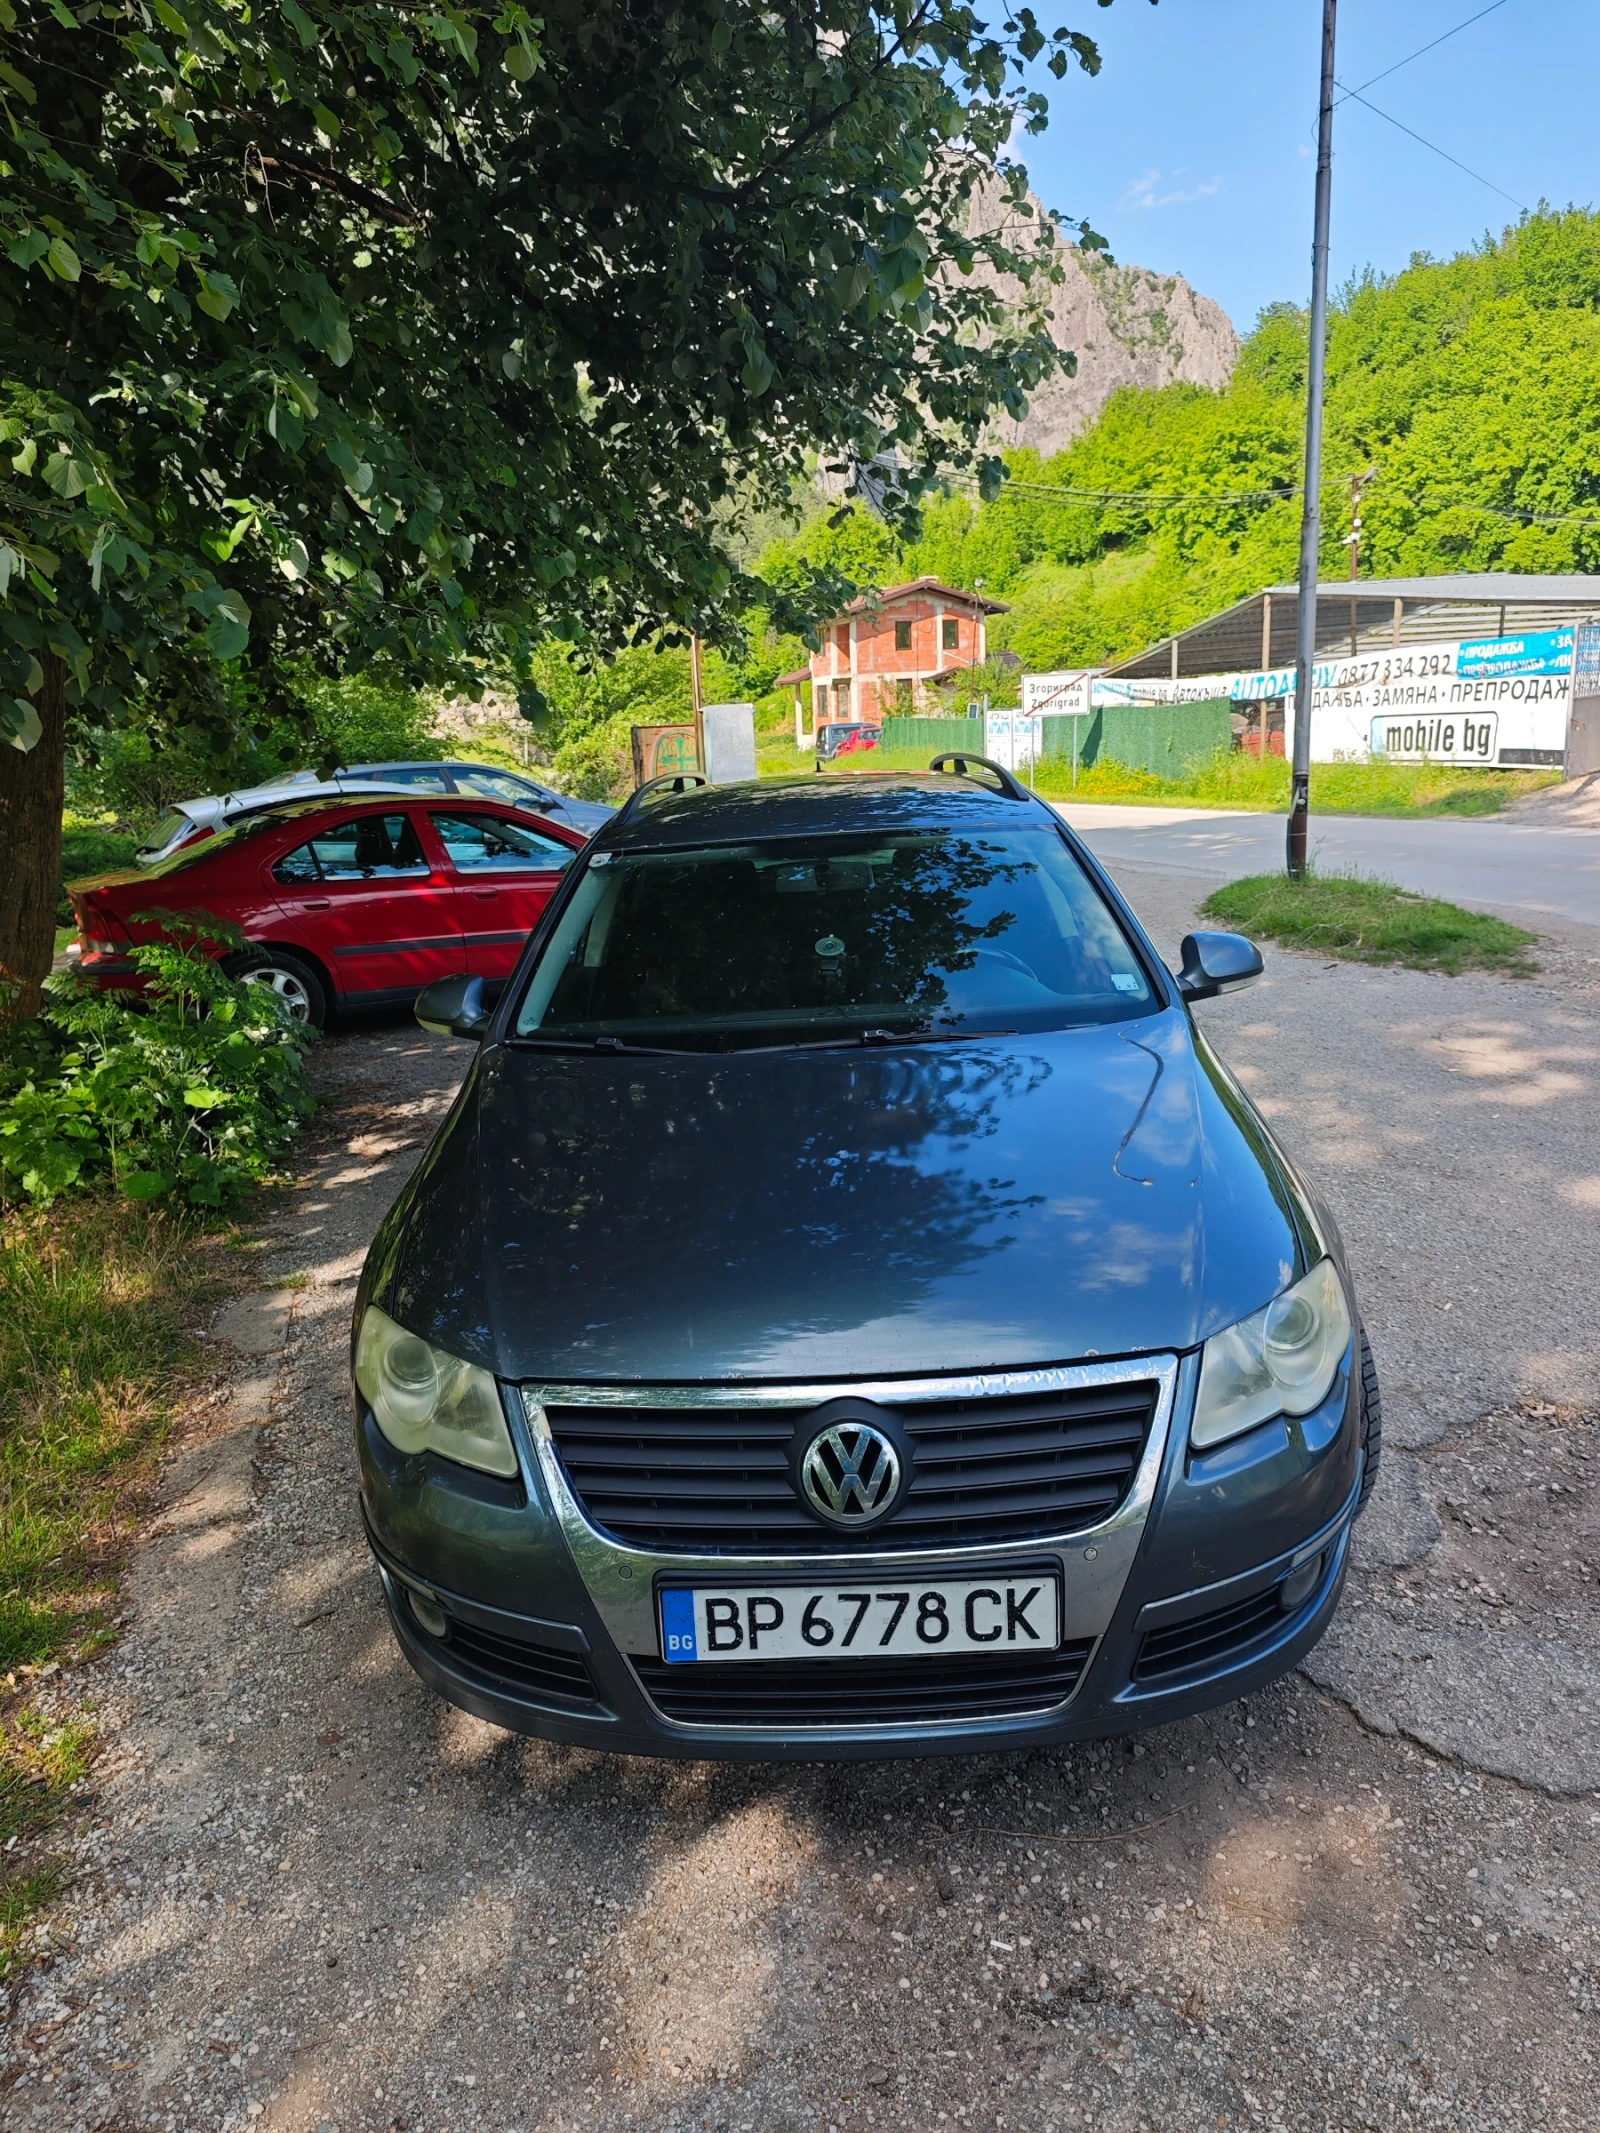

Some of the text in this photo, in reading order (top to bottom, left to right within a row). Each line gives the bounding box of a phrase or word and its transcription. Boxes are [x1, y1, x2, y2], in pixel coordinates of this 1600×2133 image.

[1465, 641, 1525, 660] ПРОДАЖБА
[1338, 661, 1379, 686] 0877
[1382, 656, 1413, 685] 334
[1418, 654, 1451, 677] 292
[1029, 683, 1083, 695] Згориград
[1287, 690, 1363, 712] ПДАЖБА
[1372, 685, 1437, 707] ЗАМЯНА
[1031, 697, 1080, 710] Zgorigrad
[1386, 718, 1491, 757] mobile bg
[706, 1586, 1042, 1652] BP 6778 CK
[668, 1633, 694, 1651] BG
